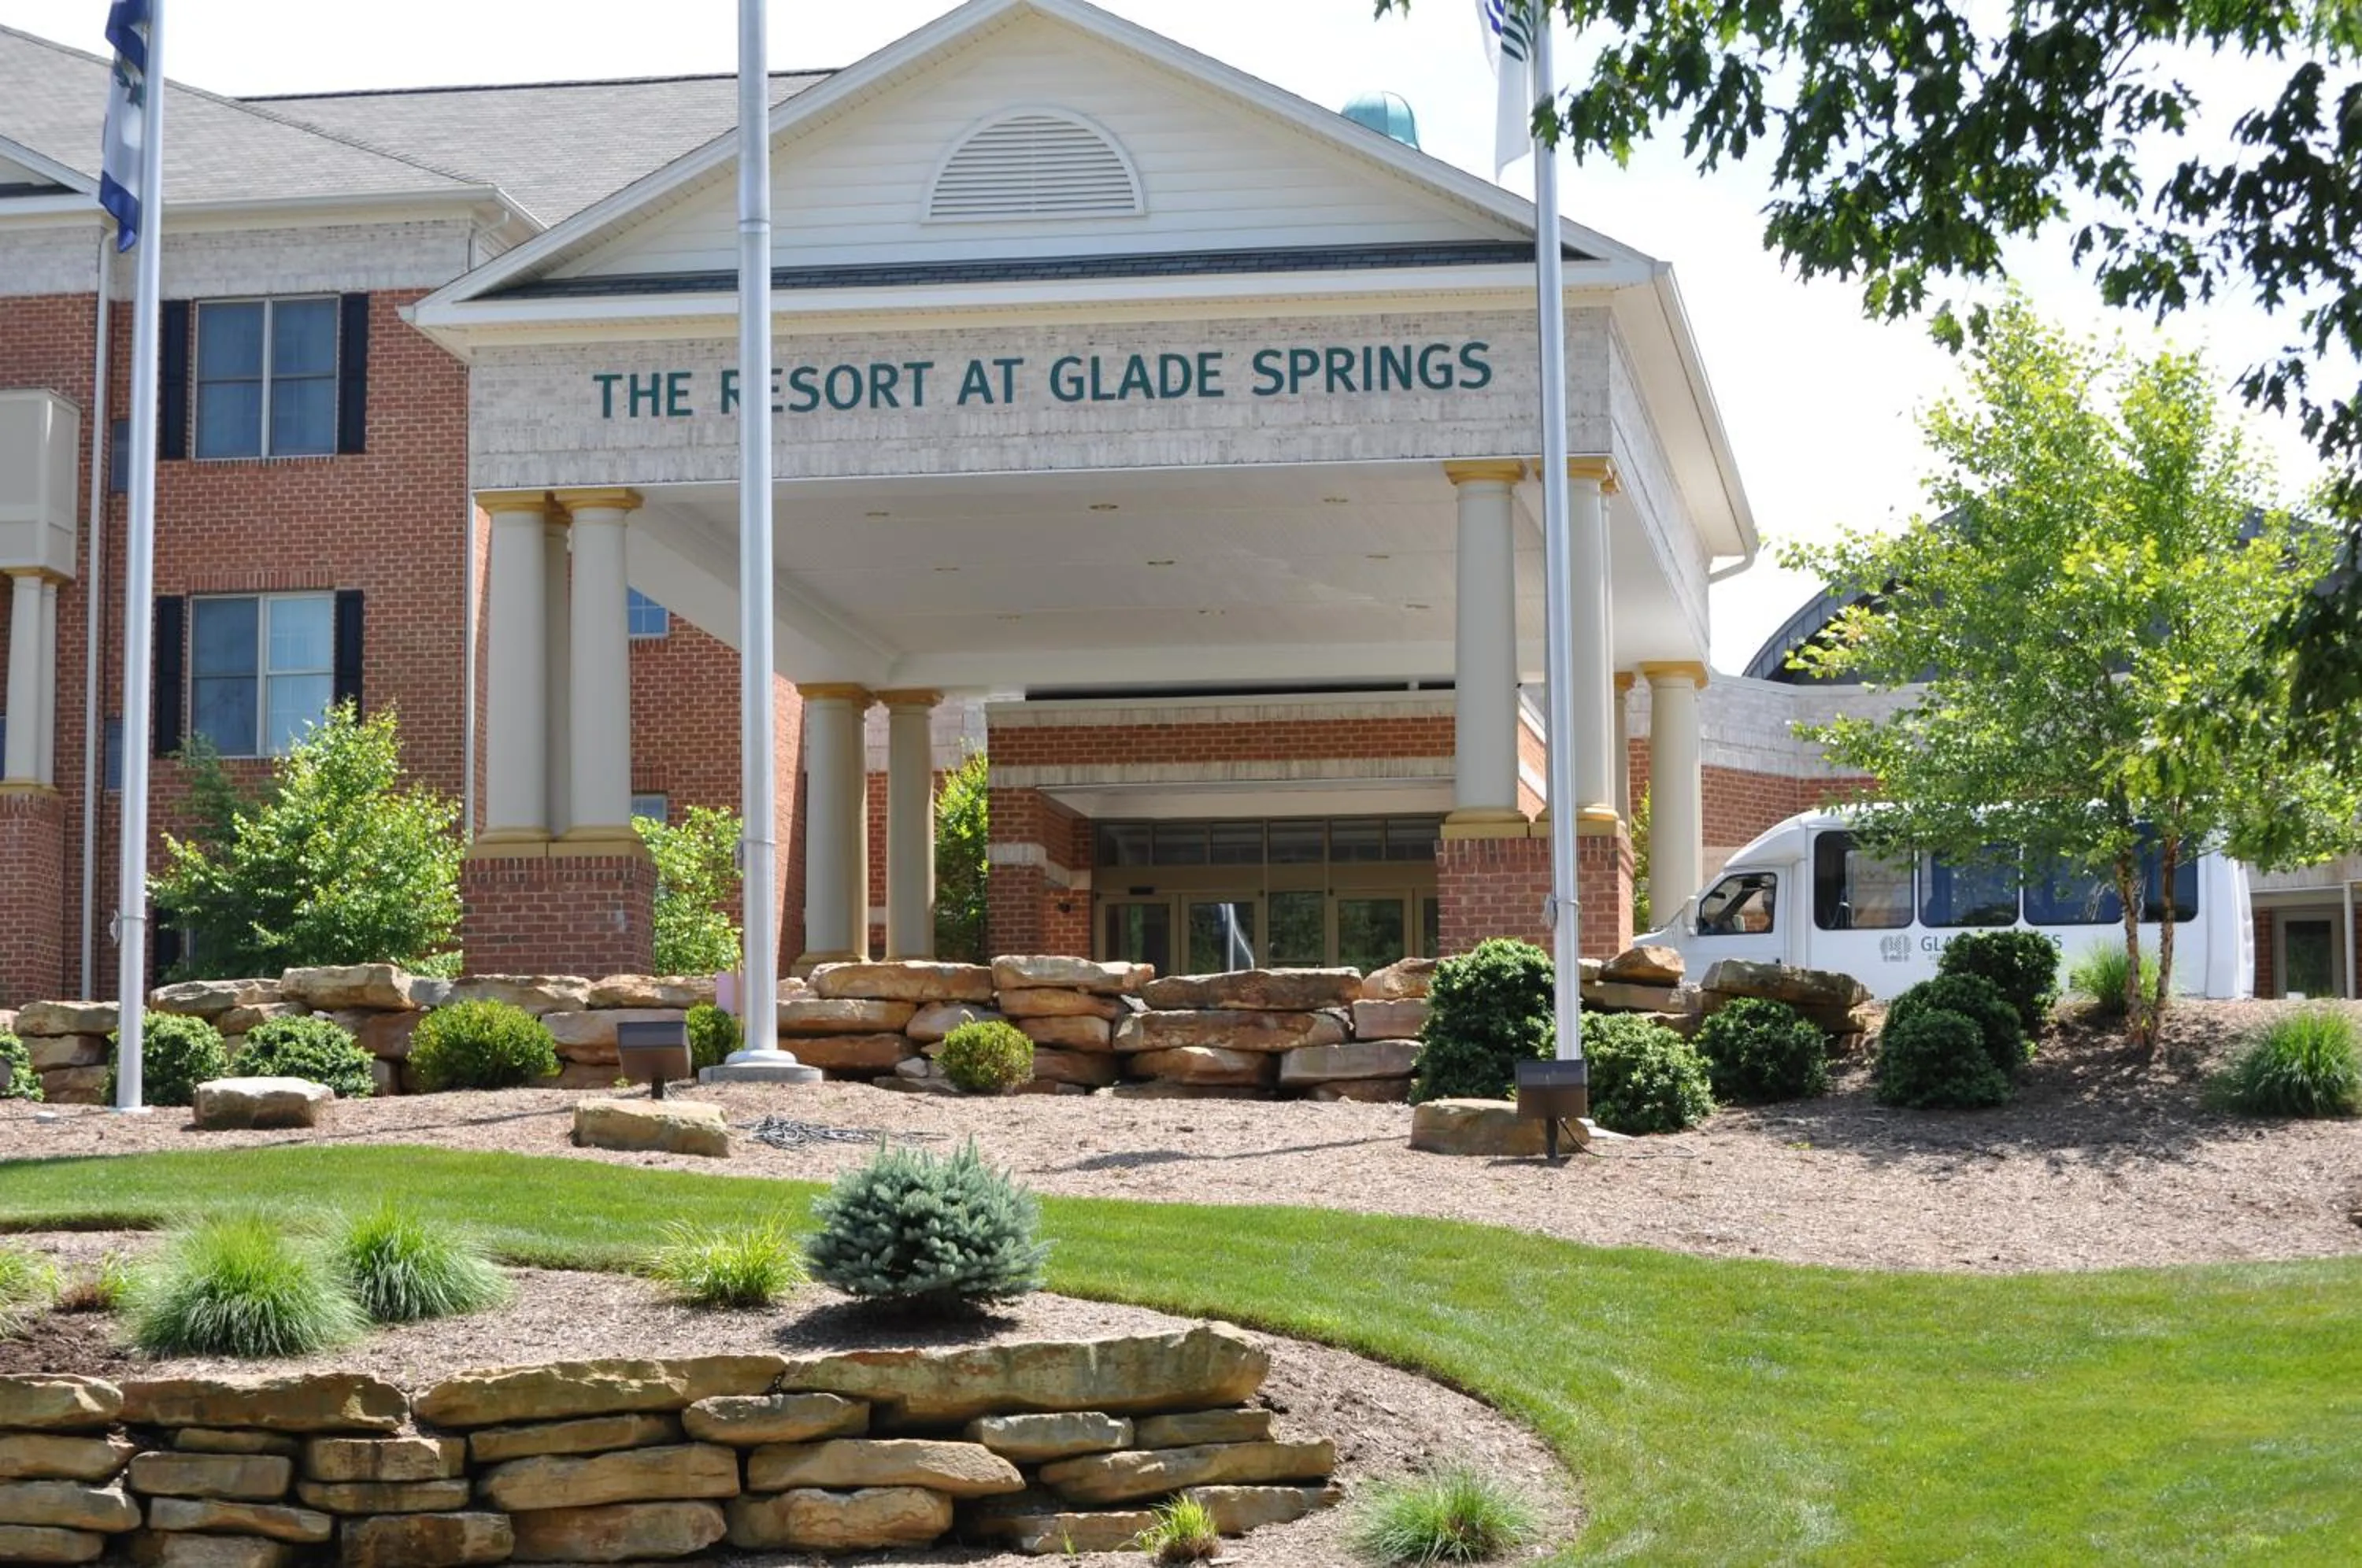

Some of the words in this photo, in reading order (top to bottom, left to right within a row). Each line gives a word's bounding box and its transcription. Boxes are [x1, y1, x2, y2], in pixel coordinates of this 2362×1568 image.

[593, 372, 693, 418] THE
[957, 358, 1024, 405] AT
[1050, 352, 1225, 402] GLADE
[1252, 342, 1492, 395] SPRINGS
